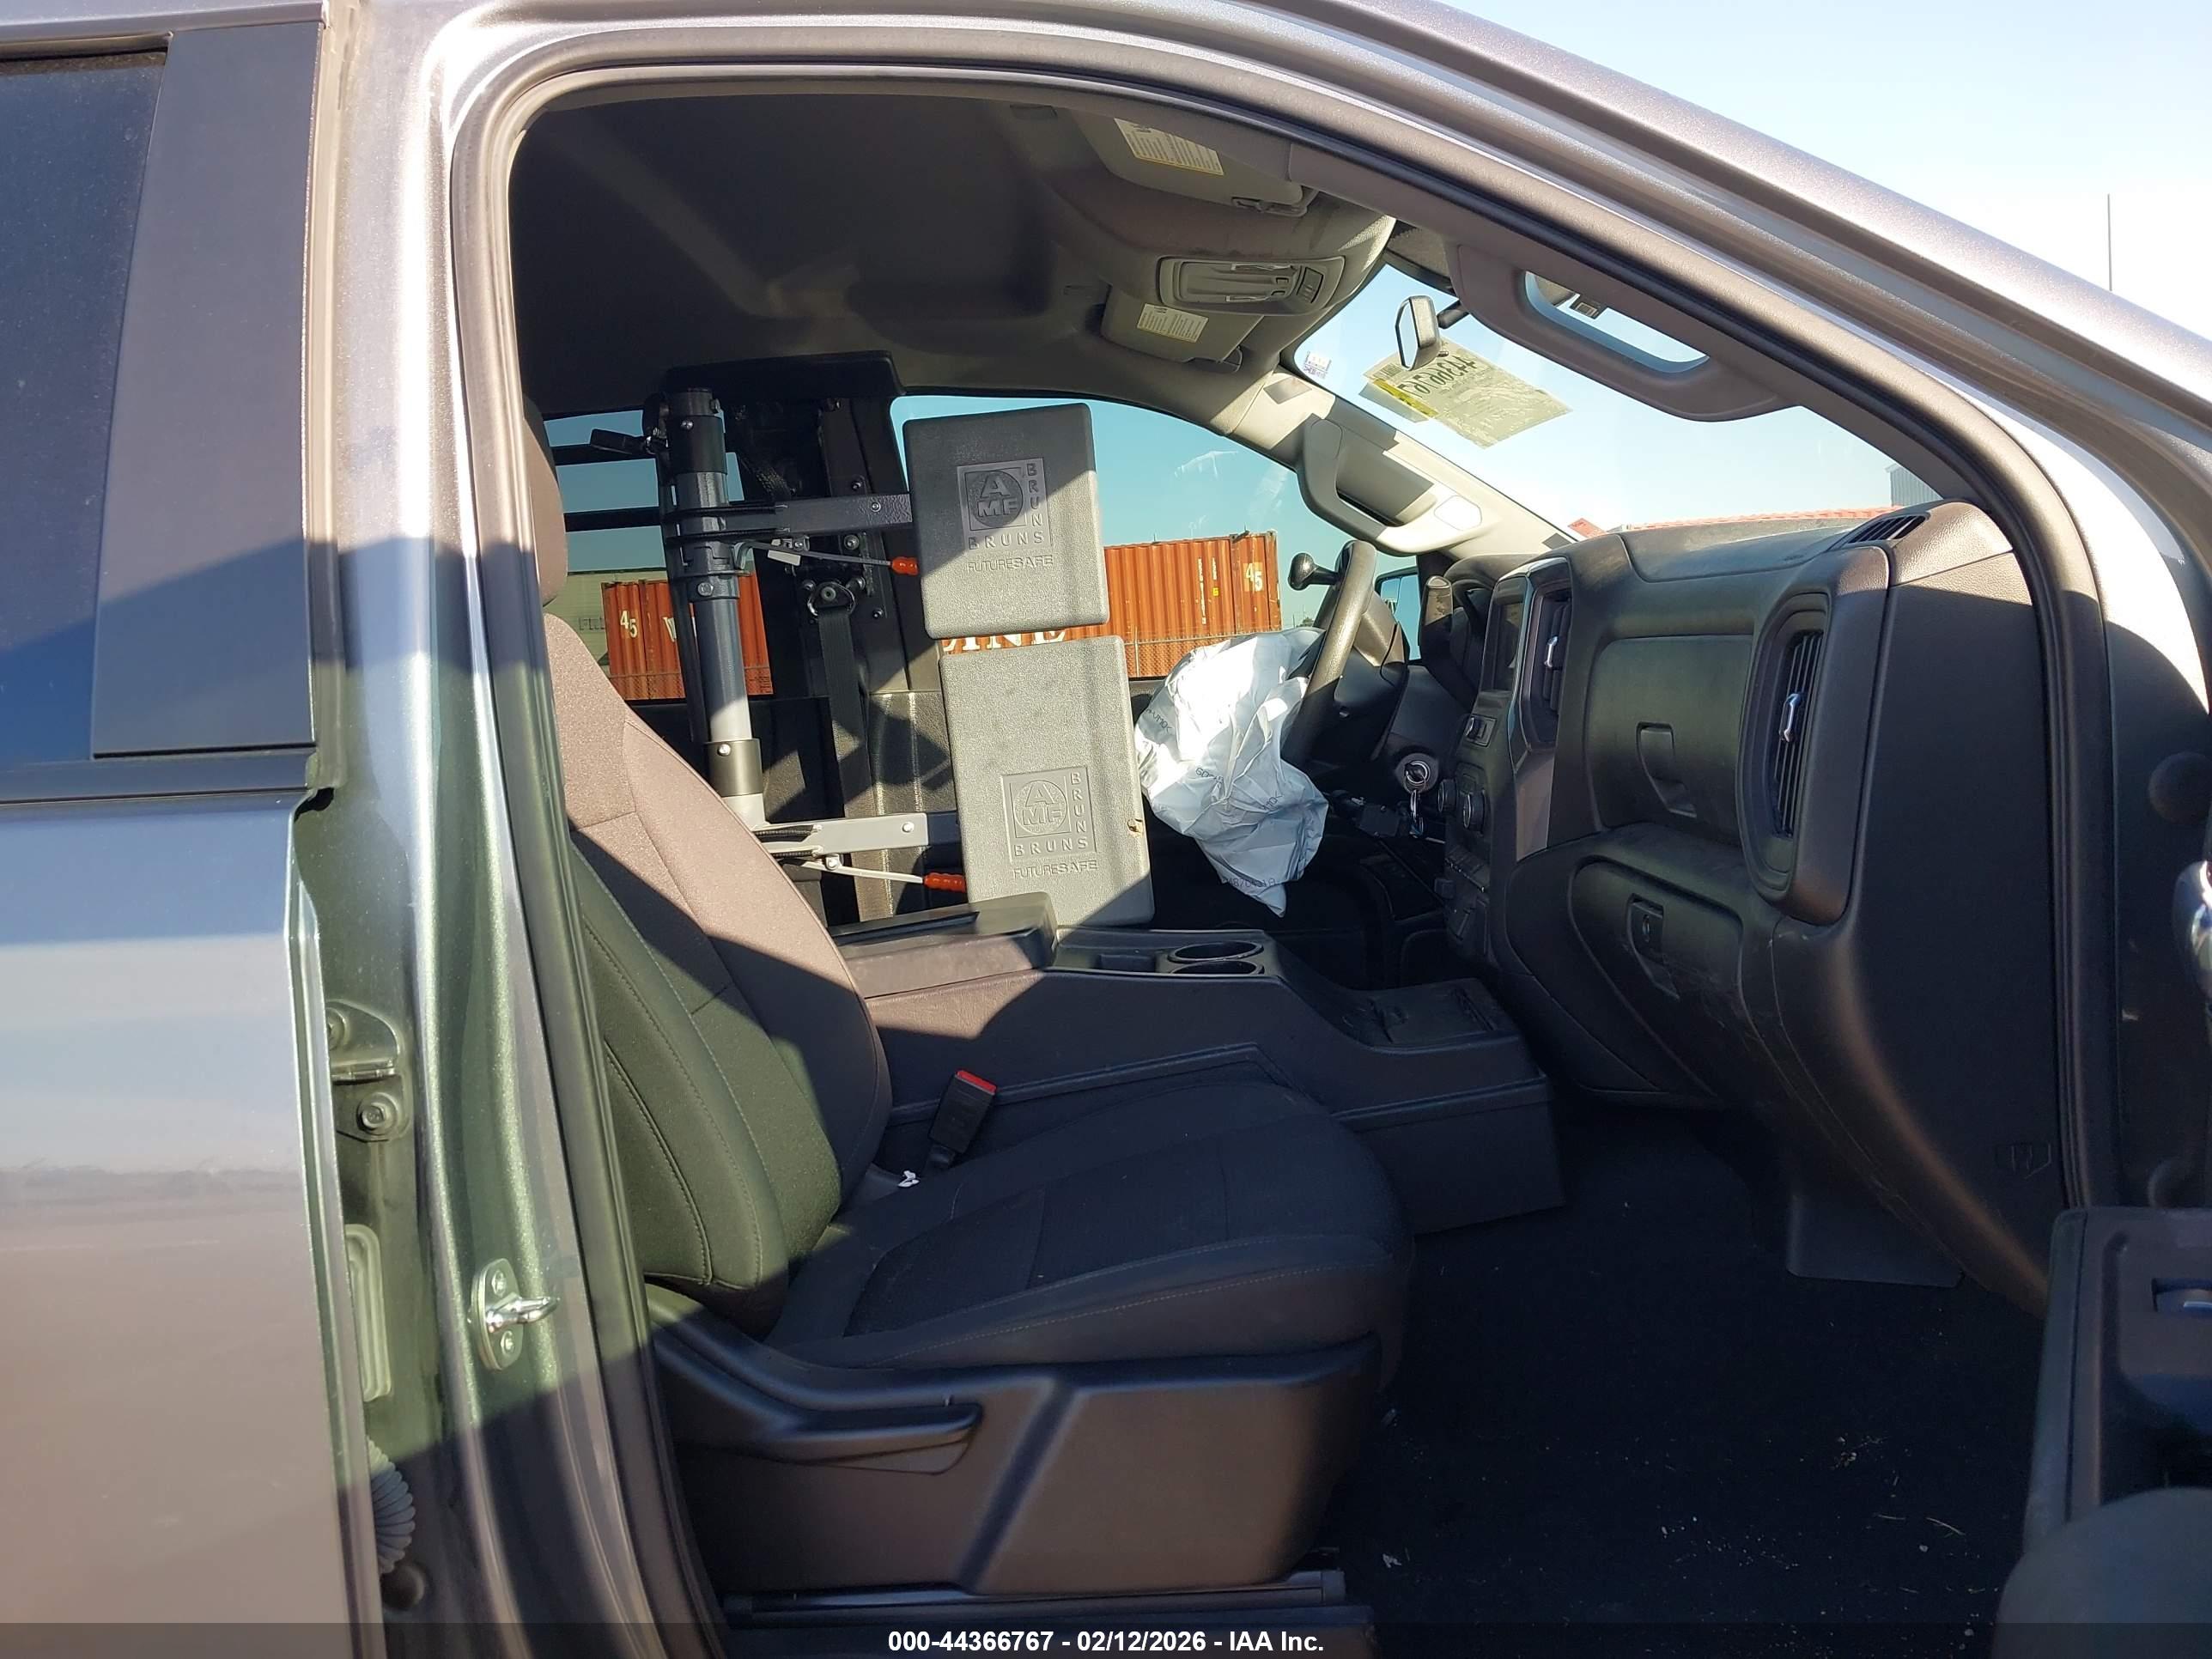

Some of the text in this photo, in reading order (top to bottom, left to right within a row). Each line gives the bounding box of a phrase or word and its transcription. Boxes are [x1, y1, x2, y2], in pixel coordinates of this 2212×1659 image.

[968, 531, 1044, 550] BRUNS
[967, 554, 1054, 573] FUTURESAFE
[619, 610, 638, 638] 45
[1013, 836, 1088, 857] BRUNS
[1013, 860, 1099, 878] FUTURESAFE
